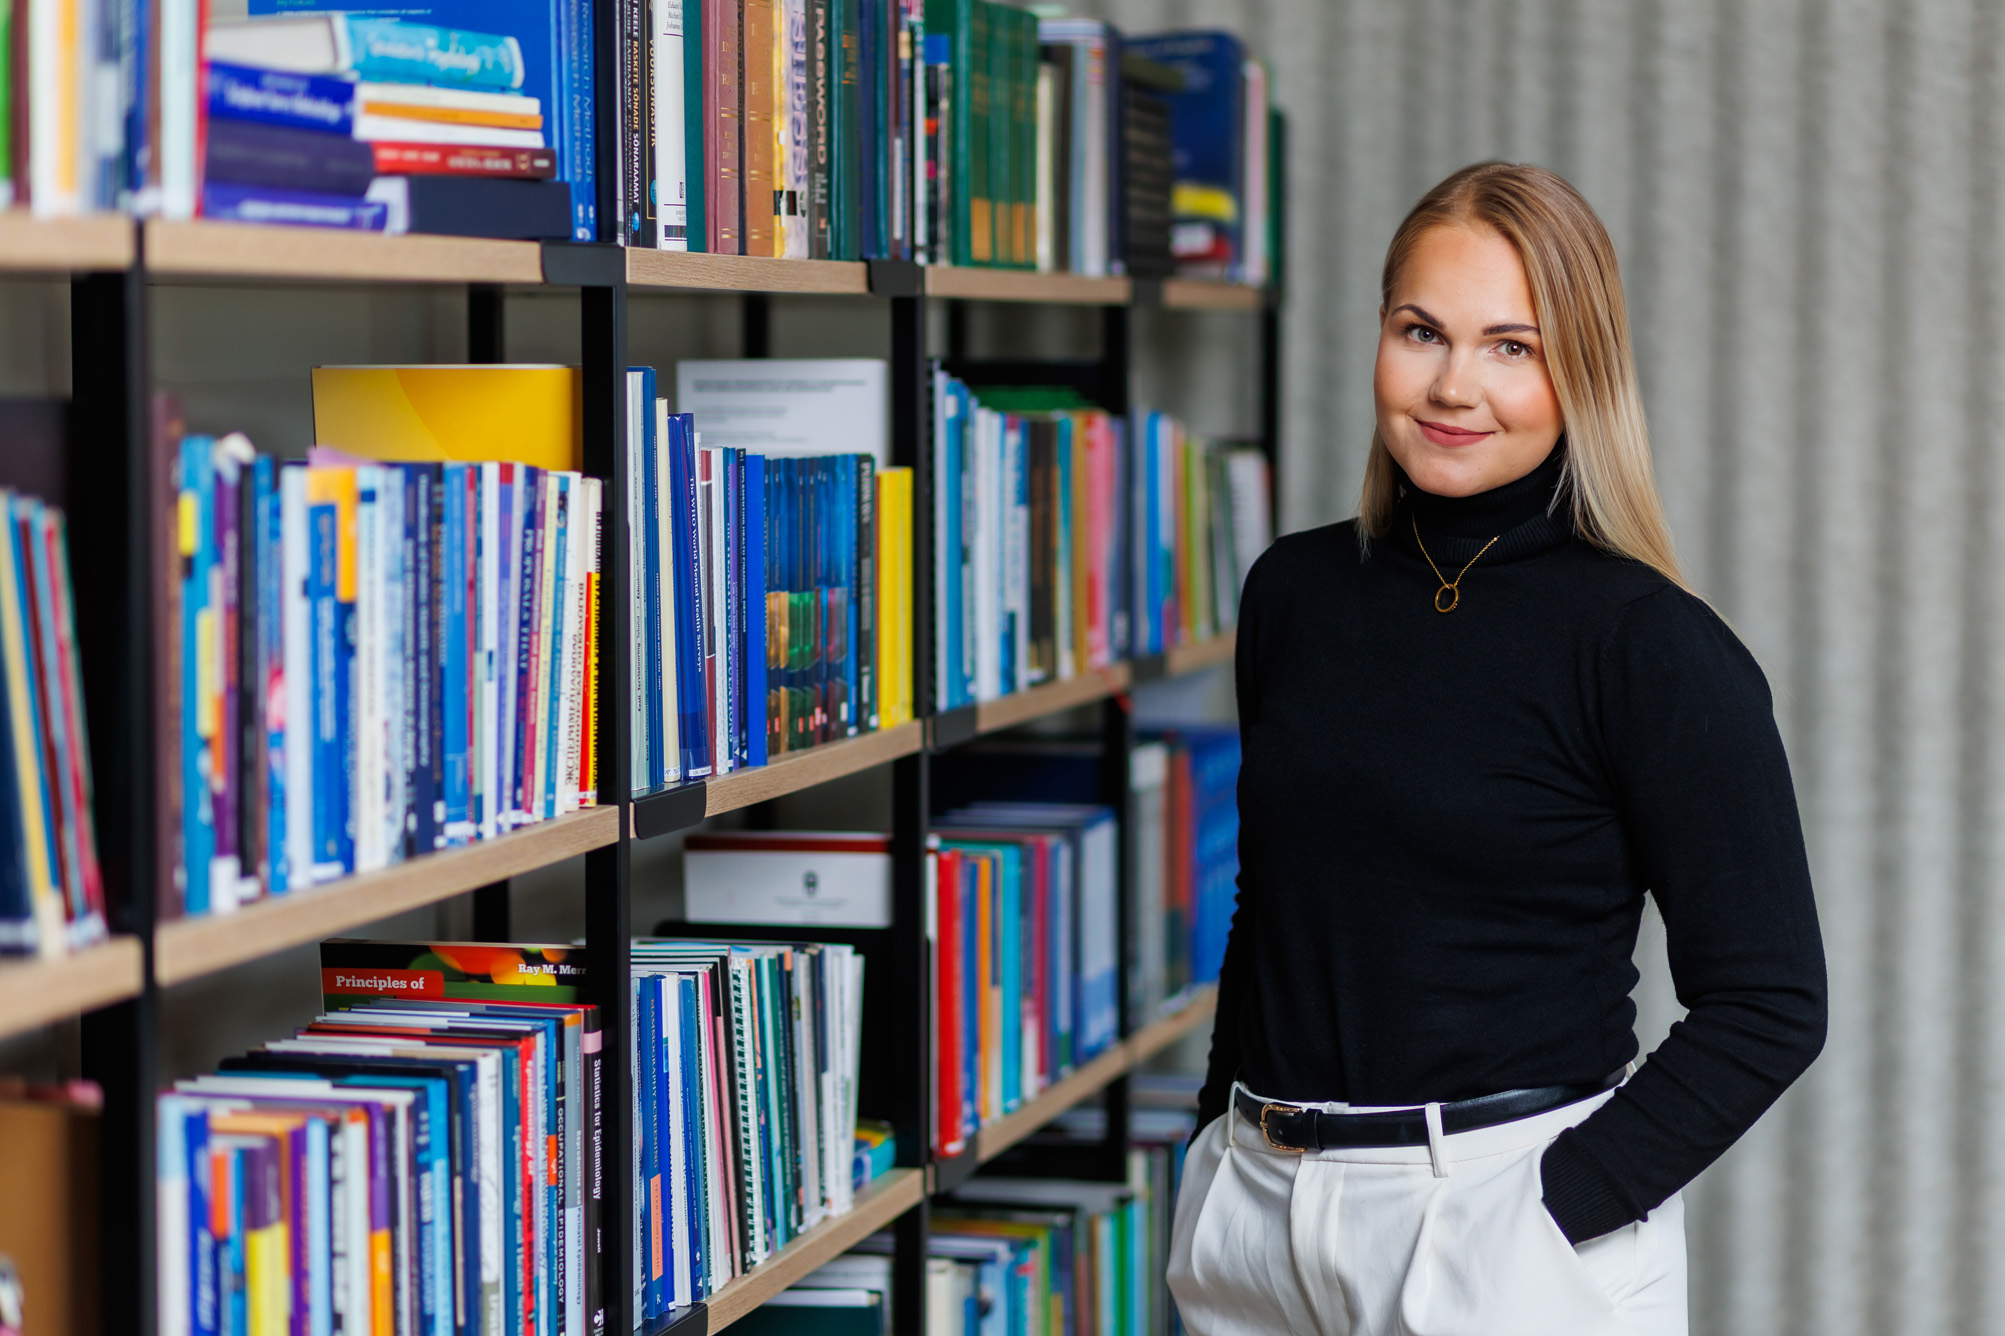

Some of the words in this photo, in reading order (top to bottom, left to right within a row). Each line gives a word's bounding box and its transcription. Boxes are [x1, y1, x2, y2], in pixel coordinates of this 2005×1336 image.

[582, 2, 592, 90] Research
[815, 8, 827, 164] PASSWORD
[573, 94, 583, 182] Methods
[584, 96, 593, 183] Methods
[633, 133, 641, 204] SÕNARAAMAT
[695, 634, 703, 673] Surveys
[336, 975, 407, 991] Principles
[410, 976, 425, 989] of
[518, 963, 540, 975] Ray
[542, 964, 557, 975] M.
[650, 998, 658, 1097] MAMMOGRAPHY
[593, 1059, 602, 1109] Statistics
[594, 1111, 602, 1126] for
[592, 1129, 602, 1200] Epidemiology
